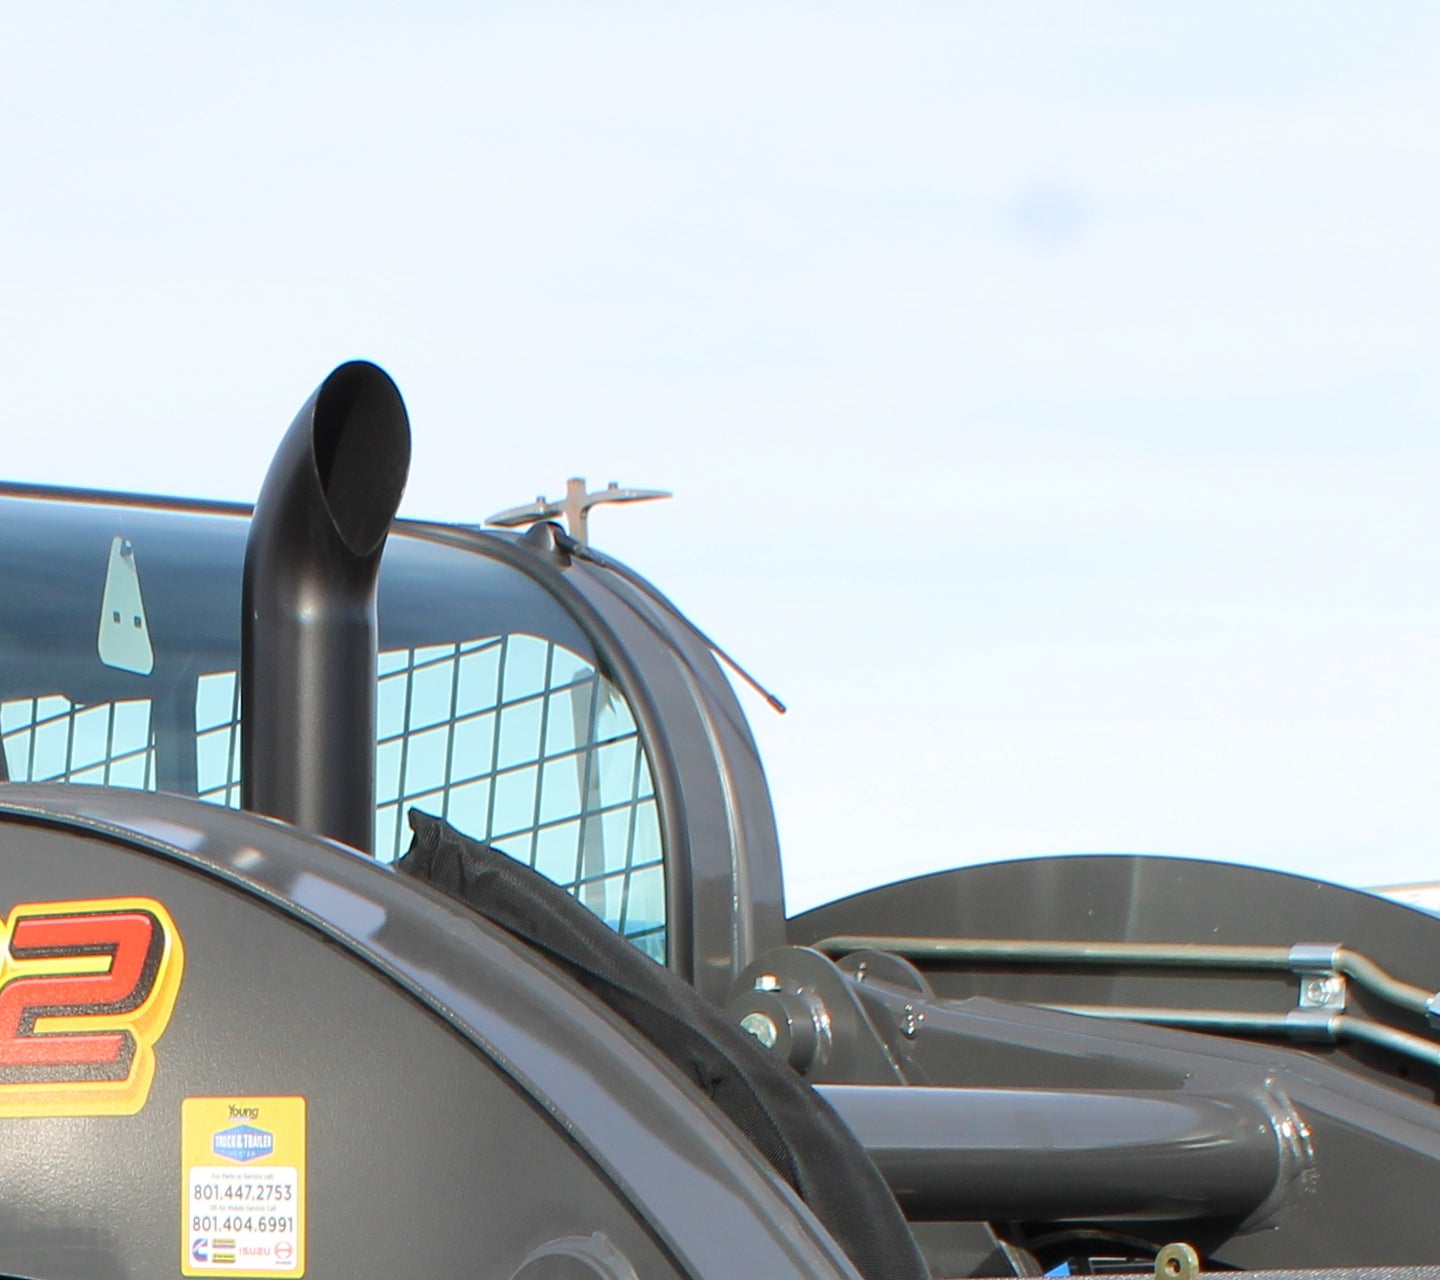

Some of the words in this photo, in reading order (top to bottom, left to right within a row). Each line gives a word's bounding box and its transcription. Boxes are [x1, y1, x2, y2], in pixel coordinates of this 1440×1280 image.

[228, 1104, 259, 1120] Young
[194, 1184, 292, 1201] 801.447.2753
[193, 1216, 293, 1233] 801.404.6991
[239, 1246, 271, 1256] ISUZU
